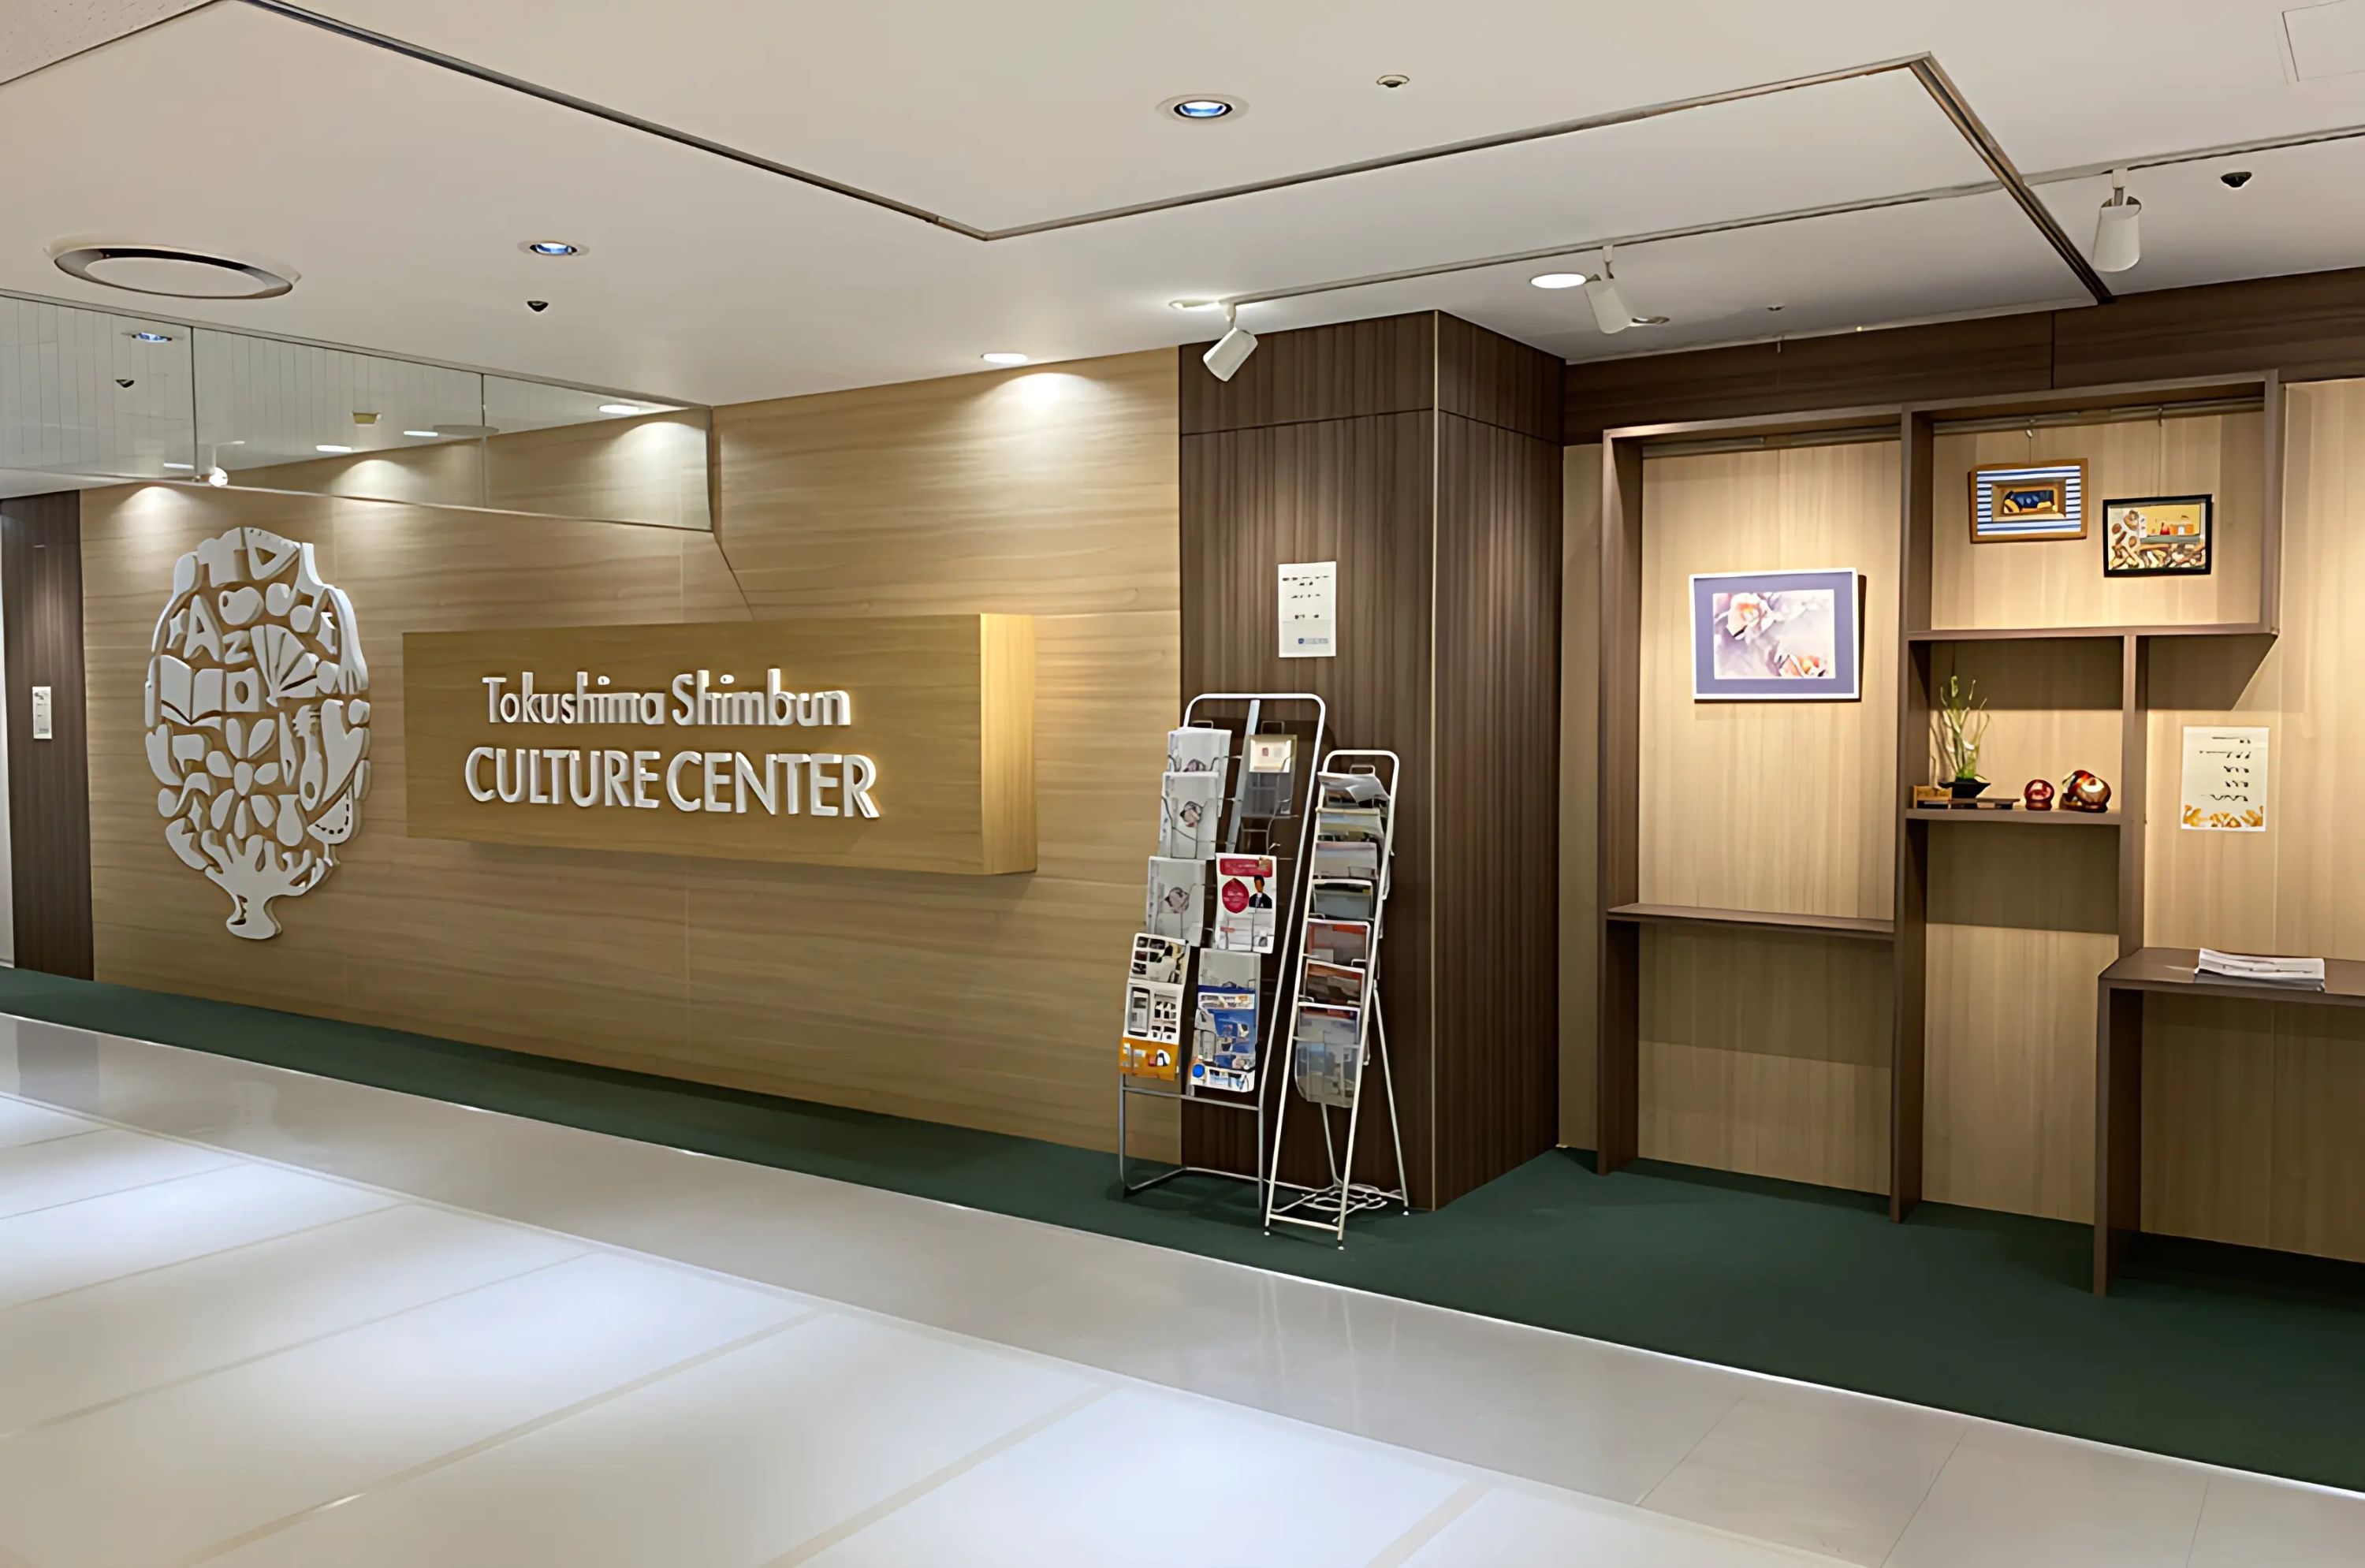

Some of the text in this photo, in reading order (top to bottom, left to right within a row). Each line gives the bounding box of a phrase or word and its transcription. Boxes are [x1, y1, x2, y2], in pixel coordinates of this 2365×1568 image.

[482, 667, 851, 726] Tokushima Shimbun
[465, 747, 881, 818] CULTURE CENTER
